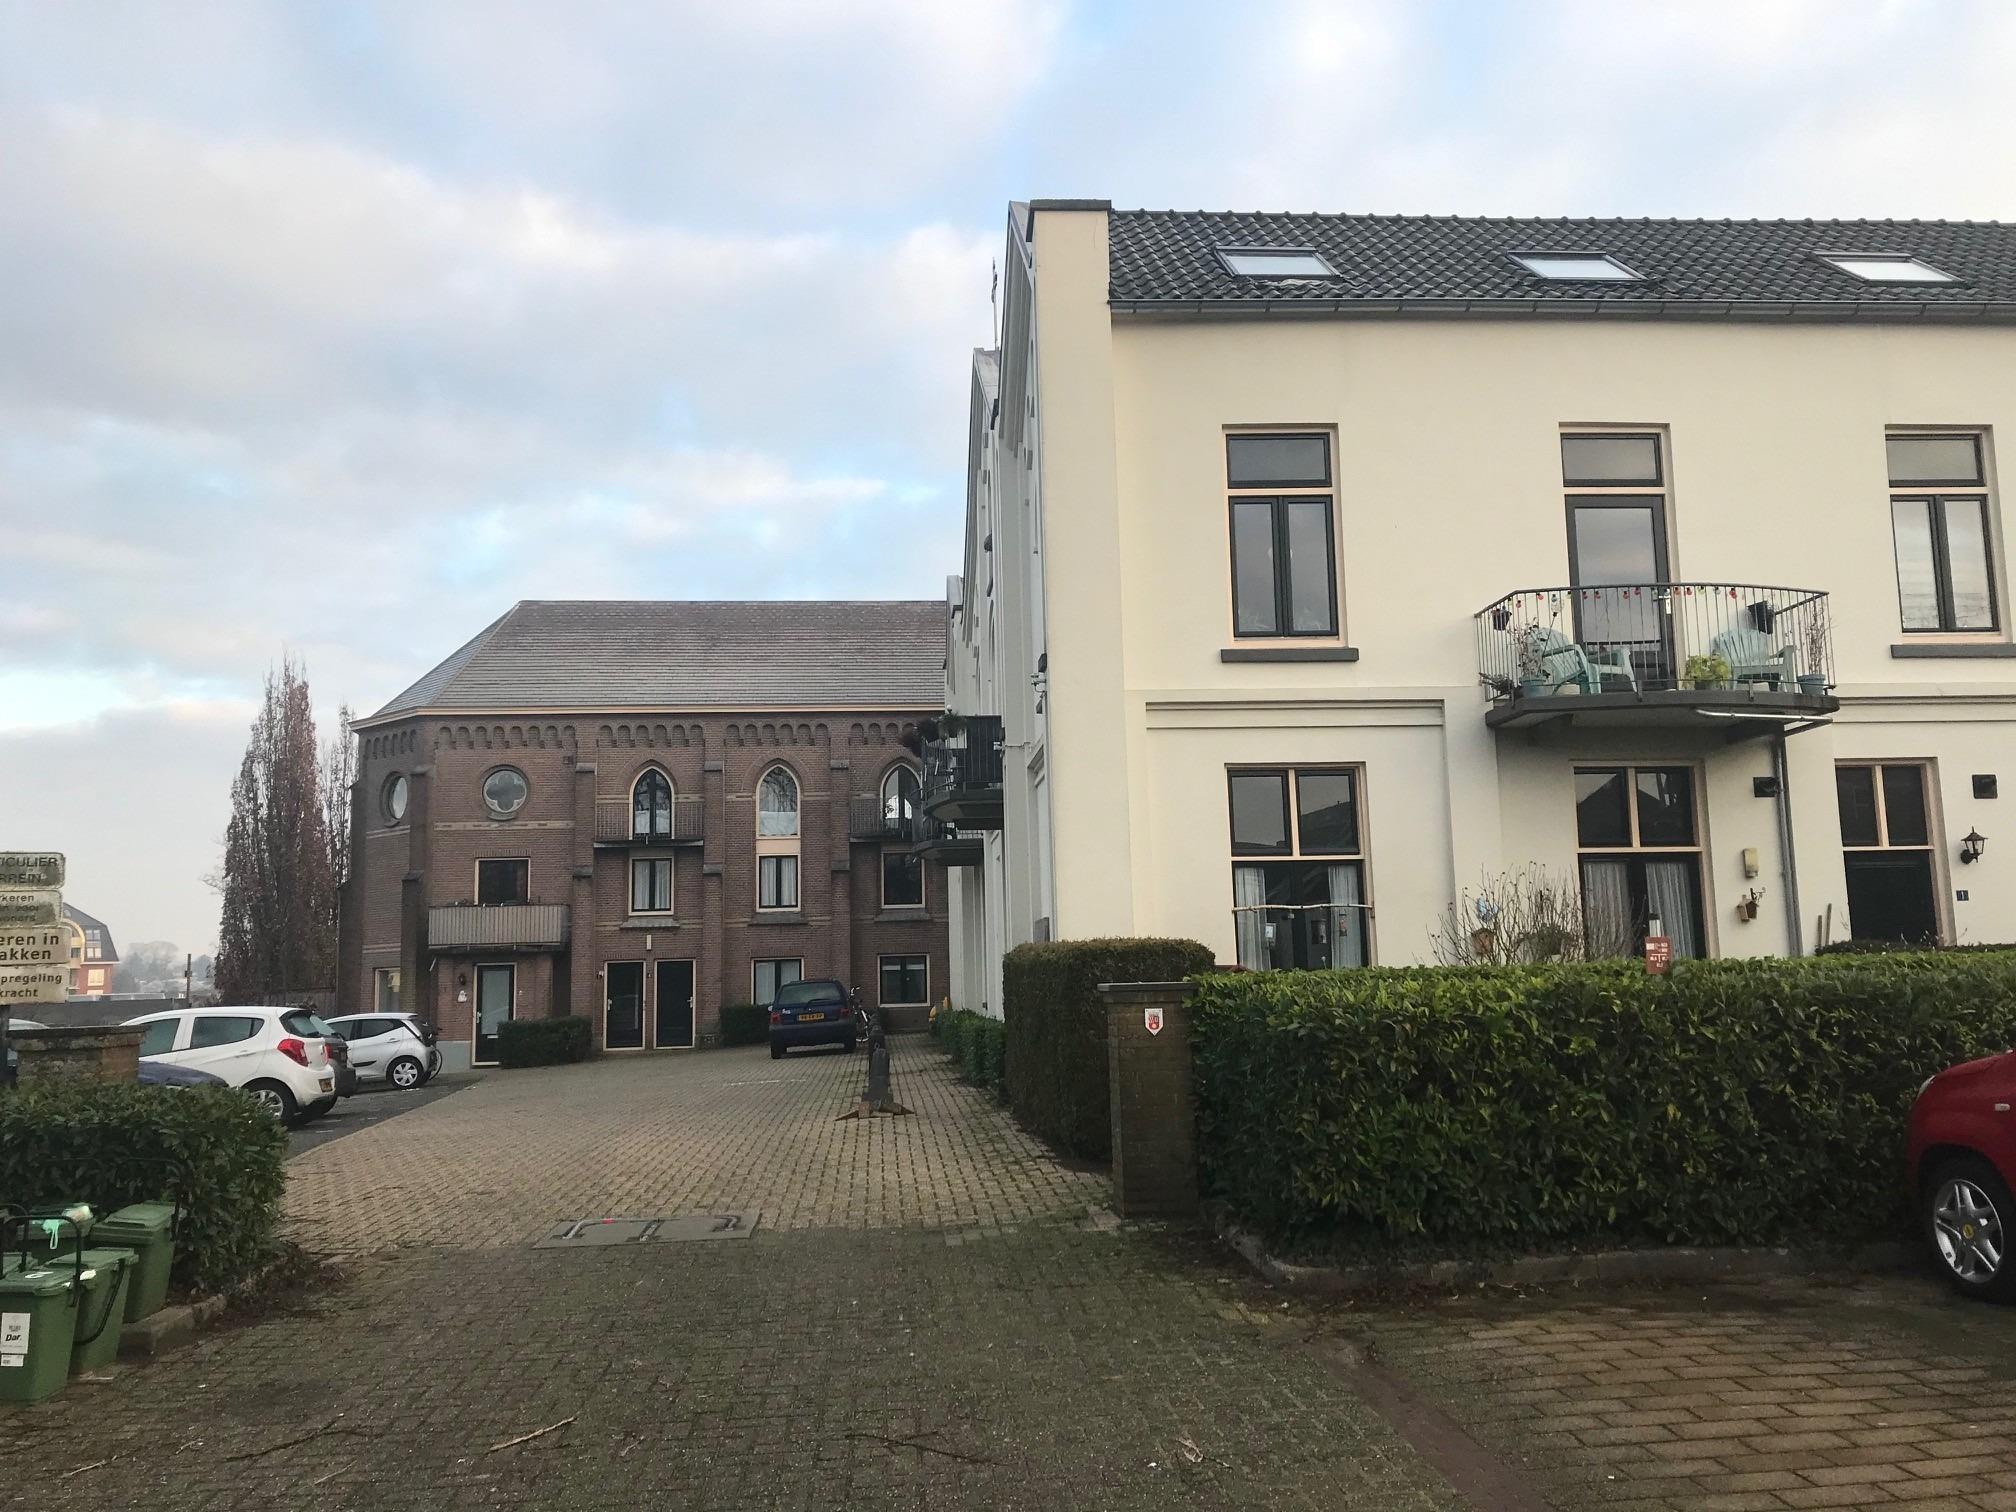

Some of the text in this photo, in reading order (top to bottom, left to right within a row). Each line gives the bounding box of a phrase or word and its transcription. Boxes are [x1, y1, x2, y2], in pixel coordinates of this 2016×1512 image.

[0, 857, 57, 867] ICULIER
[43, 933, 59, 945] in
[0, 948, 51, 960] akken
